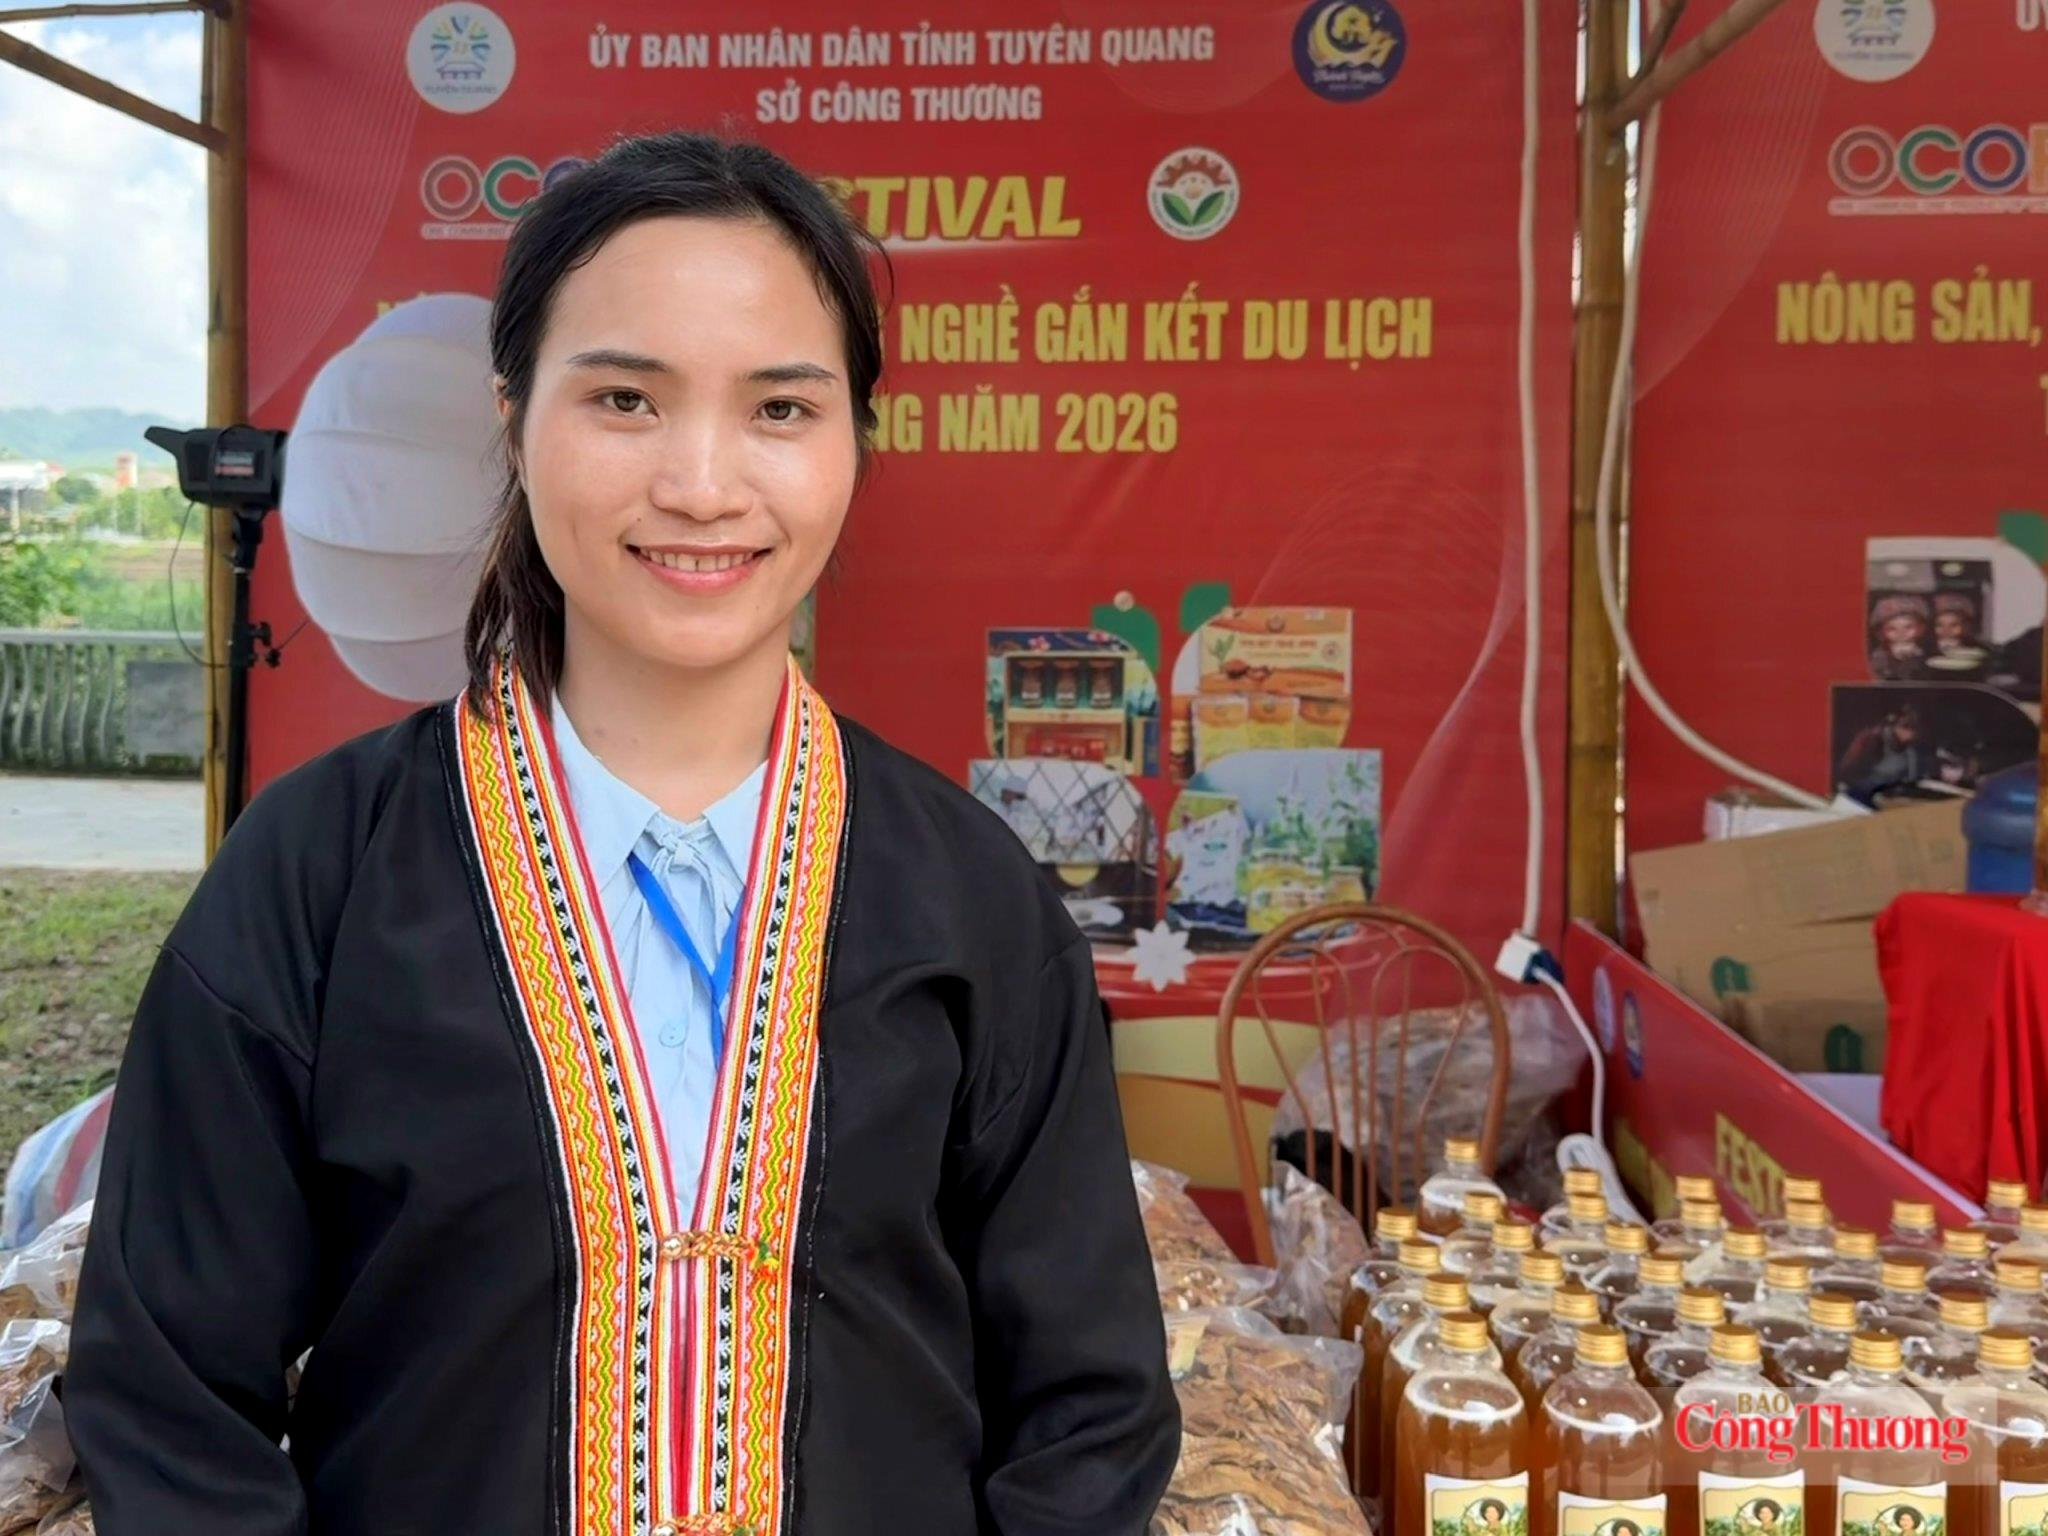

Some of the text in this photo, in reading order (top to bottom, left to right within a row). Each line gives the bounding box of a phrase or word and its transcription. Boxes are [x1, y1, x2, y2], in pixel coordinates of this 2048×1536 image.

[589, 21, 1214, 68] ỦY BAN NHÂN DÂN TỈNH TUYÊN QUANG
[755, 79, 1042, 122] SỞ CÔNG THƯƠNG
[900, 284, 1019, 363] NGHỀ
[1035, 285, 1128, 362] GẮN
[1143, 281, 1229, 361] KẾT
[1243, 300, 1309, 360] DU
[1324, 298, 1433, 370] LỊCH
[1776, 264, 2043, 348] NÔNG SẢN,
[938, 384, 1040, 452] NĂM
[1055, 393, 1178, 452] 2026
